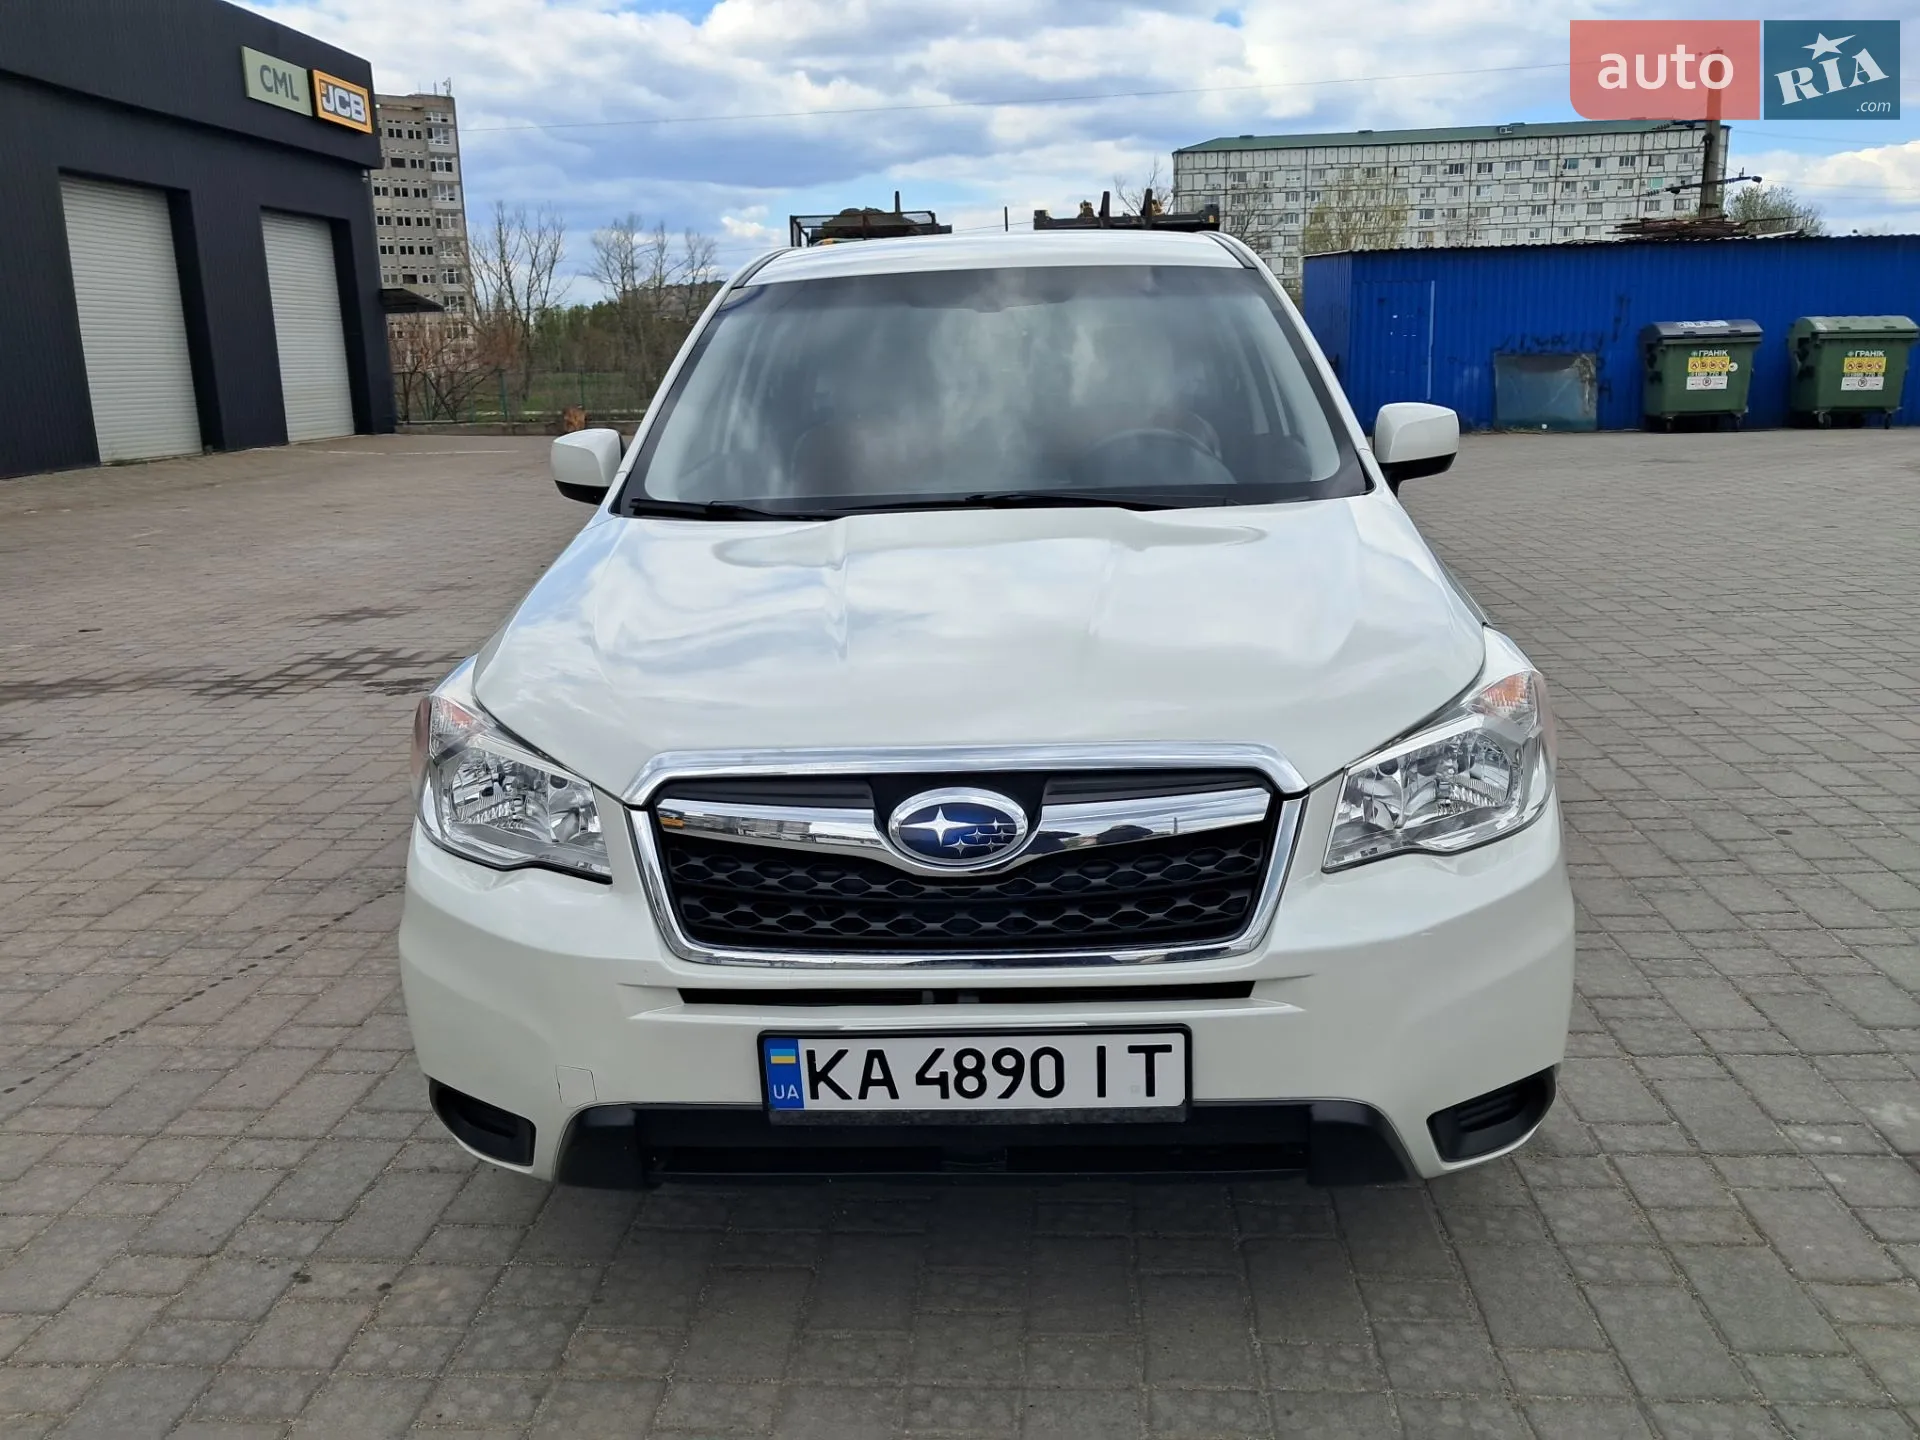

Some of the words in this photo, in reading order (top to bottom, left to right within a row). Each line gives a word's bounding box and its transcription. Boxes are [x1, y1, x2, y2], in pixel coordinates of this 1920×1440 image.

[259, 64, 299, 102] CML
[321, 82, 366, 123] JCB
[806, 1048, 899, 1100] KA
[915, 1046, 1065, 1100] 4890
[1096, 1044, 1173, 1098] IT
[772, 1084, 799, 1100] UA
